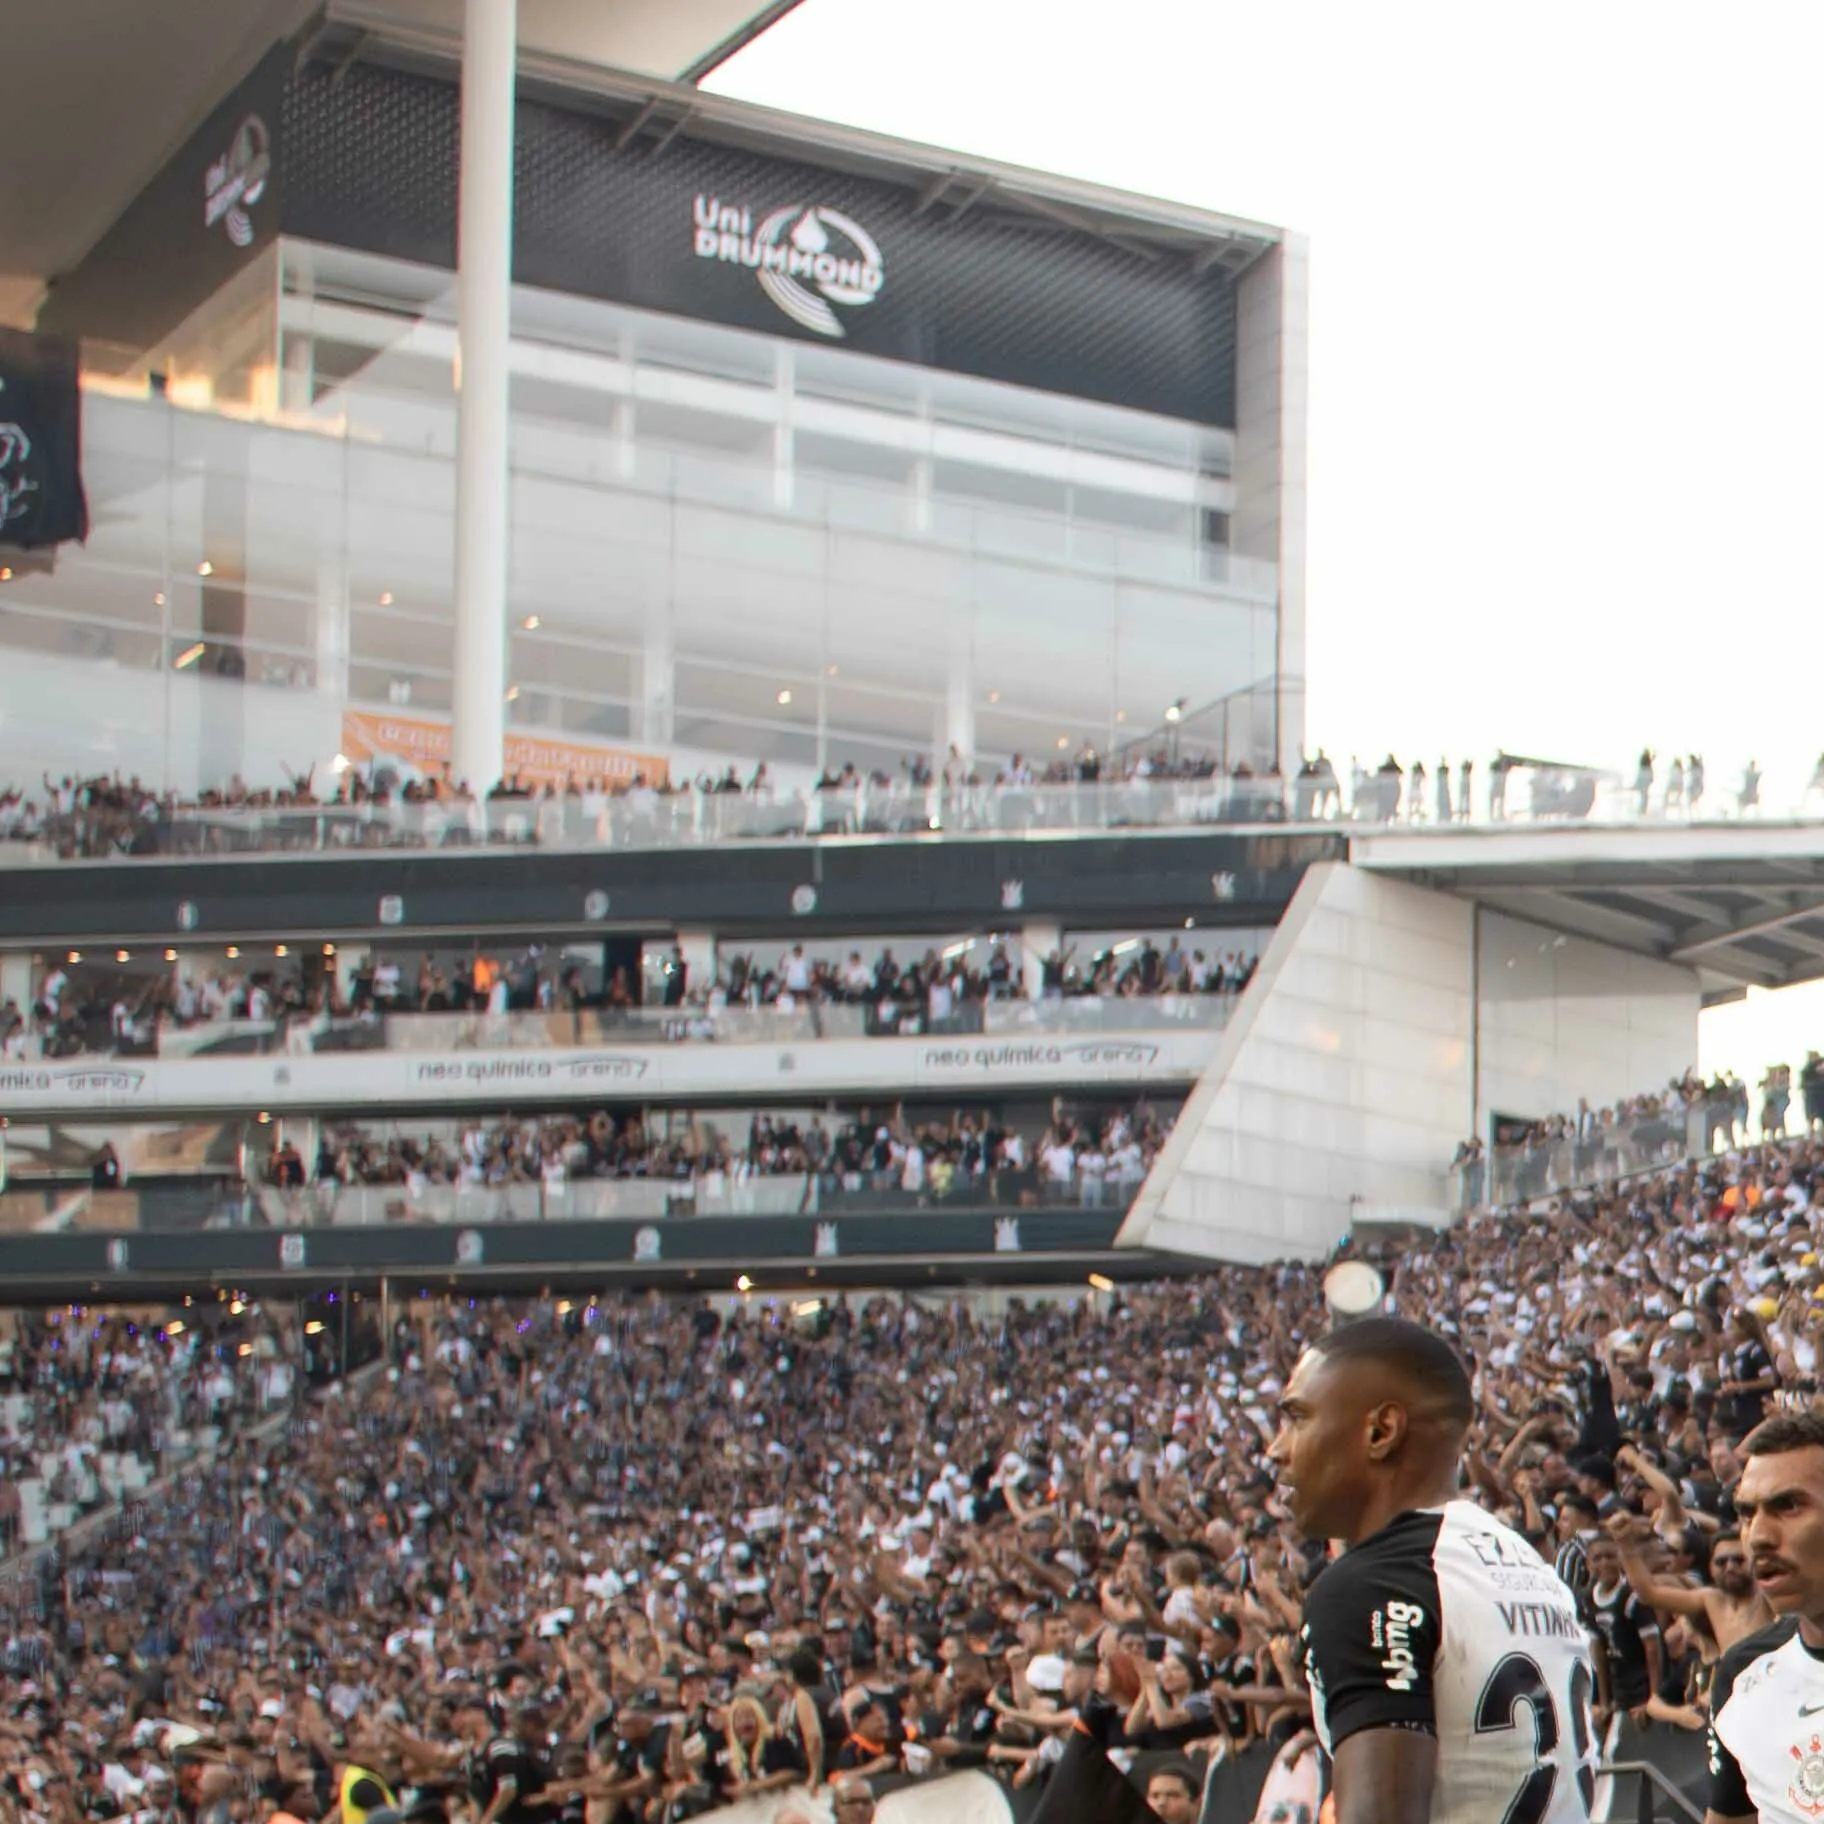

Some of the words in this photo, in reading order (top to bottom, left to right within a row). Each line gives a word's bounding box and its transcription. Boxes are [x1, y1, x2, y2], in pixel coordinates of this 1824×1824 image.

[694, 195, 750, 237] Uni
[694, 230, 885, 292] DRUMMOND
[1381, 1600, 1425, 1672] bmg
